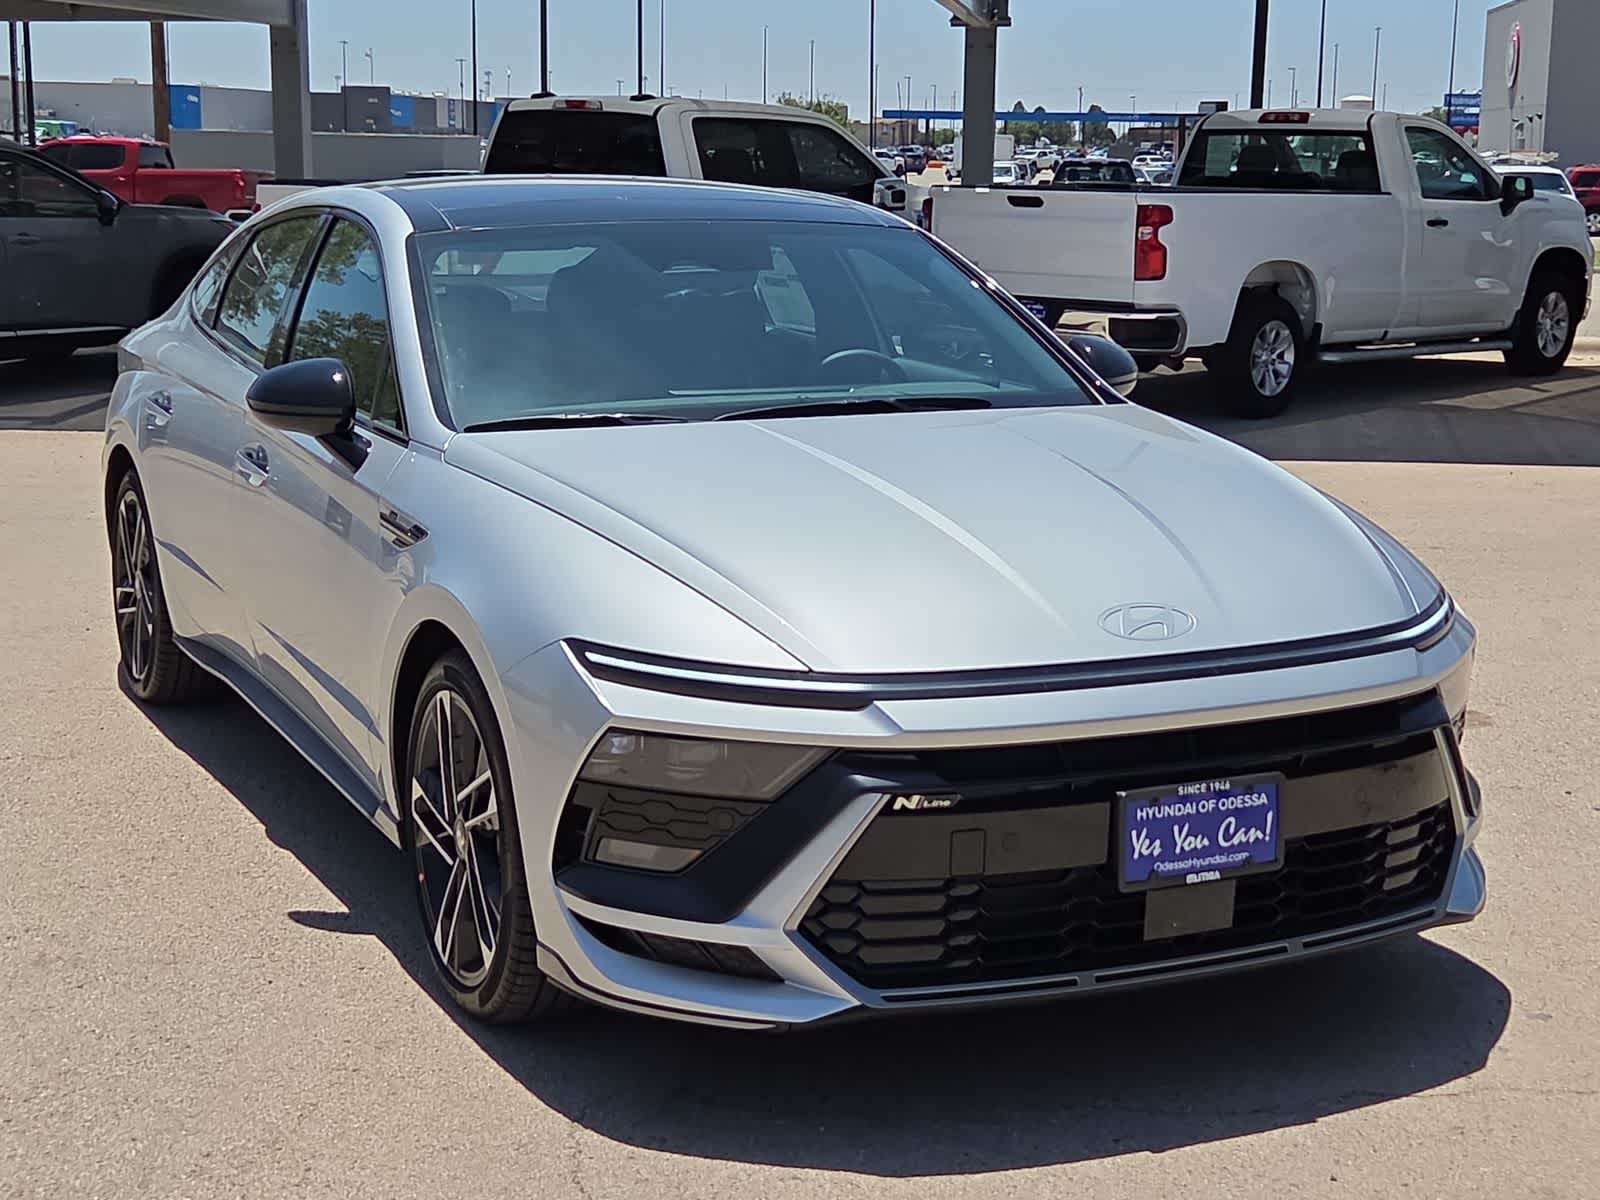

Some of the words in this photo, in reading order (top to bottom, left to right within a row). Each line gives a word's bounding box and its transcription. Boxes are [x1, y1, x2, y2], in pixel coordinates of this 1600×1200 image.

[1178, 783, 1207, 796] SINCE
[1137, 802, 1196, 821] HYUNDAI
[1198, 799, 1217, 813] OF
[1218, 793, 1268, 810] ODESSA
[1131, 827, 1162, 860] Yes
[1173, 822, 1210, 855] You
[1218, 810, 1273, 848] Can!
[1154, 851, 1250, 872] OdessaHyundai.com
